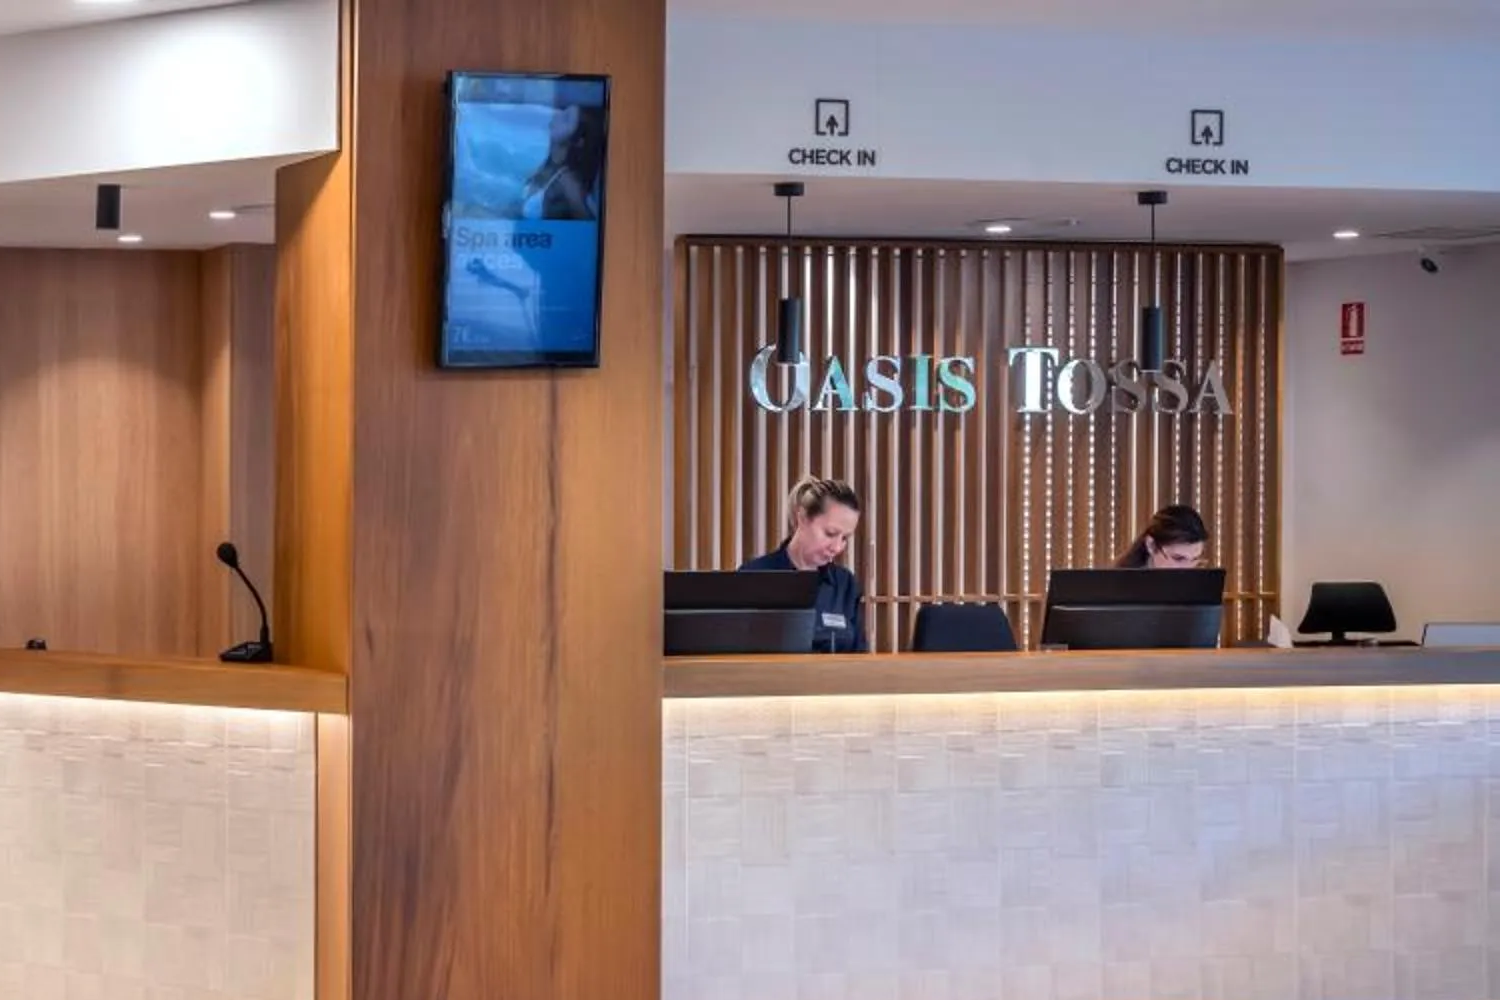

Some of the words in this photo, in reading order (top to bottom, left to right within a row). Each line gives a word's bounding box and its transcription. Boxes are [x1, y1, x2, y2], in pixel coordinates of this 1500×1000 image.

[788, 147, 852, 166] CHECK
[857, 149, 876, 167] IN
[1165, 157, 1226, 175] CHECK
[1230, 159, 1249, 175] IN
[750, 343, 977, 413] OASIS
[1008, 346, 1234, 415] TOSSA
